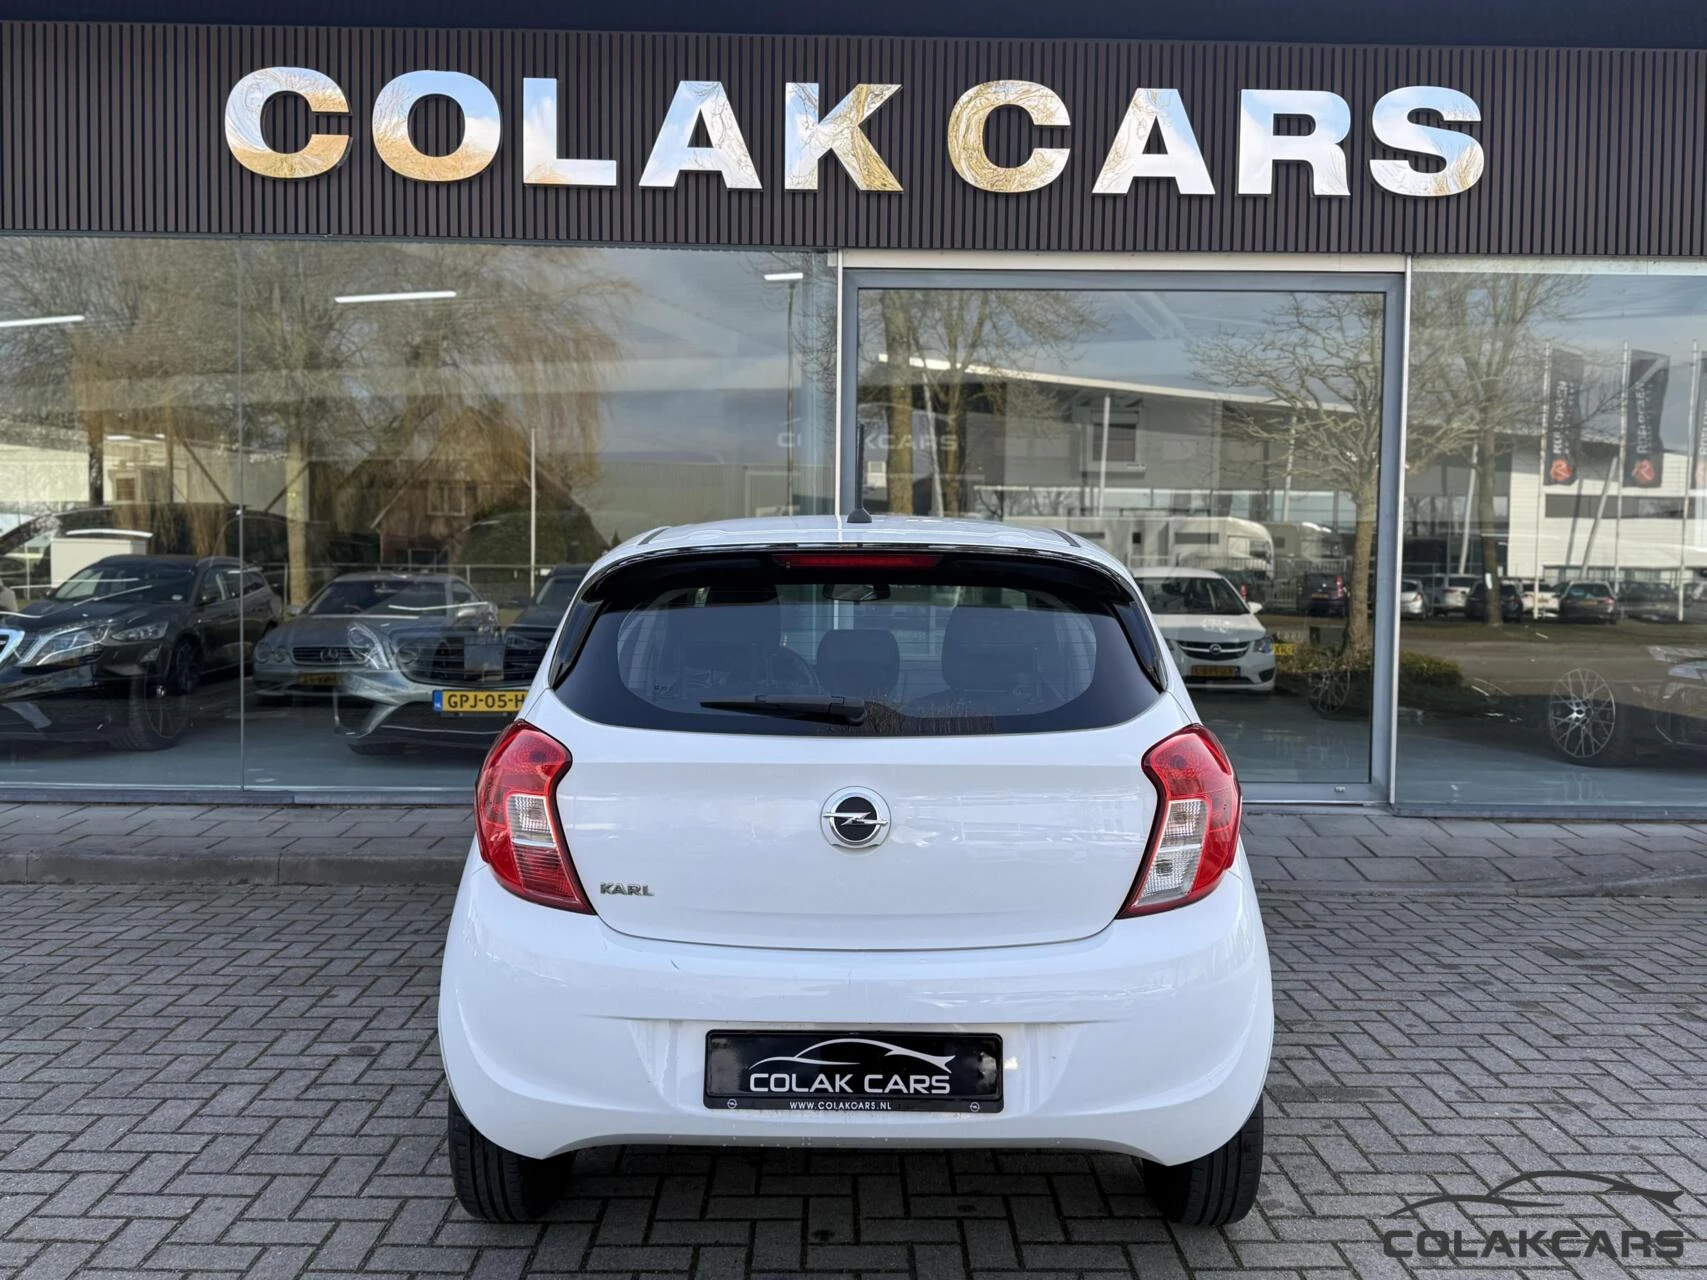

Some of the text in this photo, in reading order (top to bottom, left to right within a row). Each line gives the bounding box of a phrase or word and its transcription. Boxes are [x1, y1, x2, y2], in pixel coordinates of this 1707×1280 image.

[225, 66, 1486, 198] COLAK CARS
[447, 694, 525, 709] GPJ-05-H
[600, 882, 655, 896] KARL
[750, 1073, 950, 1095] COLAK CARS
[789, 1101, 892, 1111] WWW.COLAKCARS.NL
